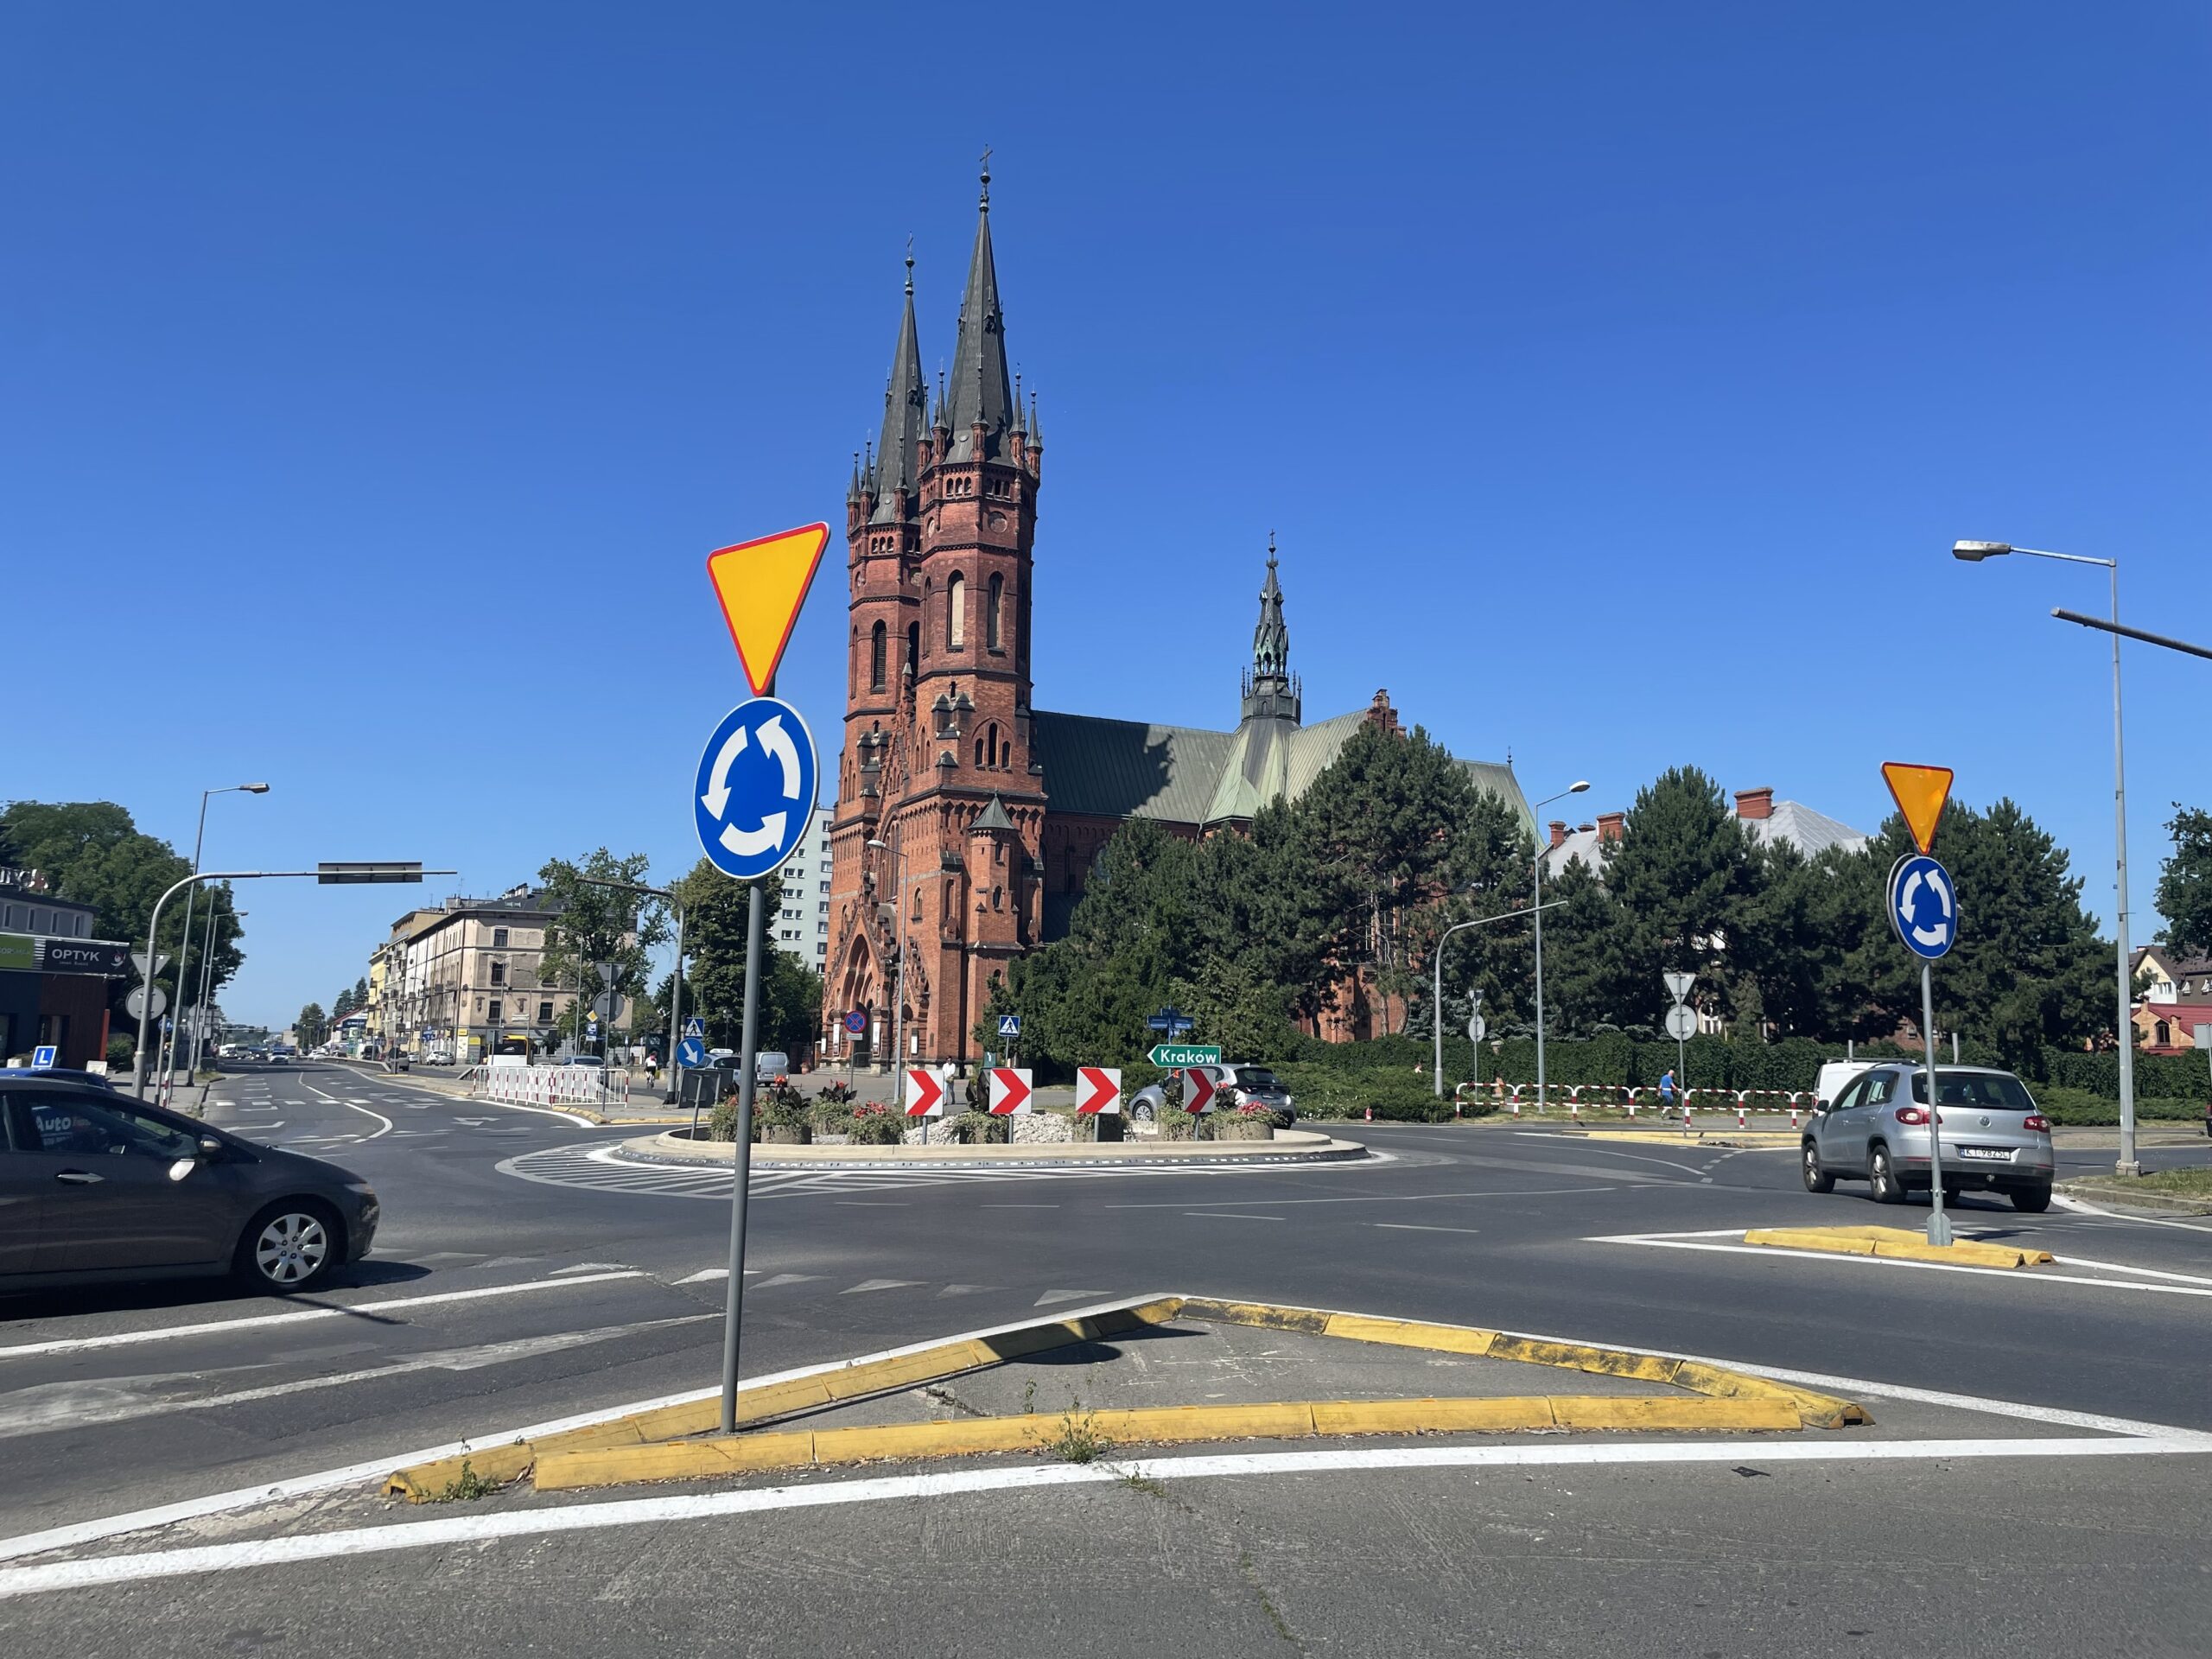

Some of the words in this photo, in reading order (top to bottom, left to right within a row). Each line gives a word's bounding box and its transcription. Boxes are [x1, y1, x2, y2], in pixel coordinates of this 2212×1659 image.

[52, 949, 100, 962] OPTYK
[39, 1050, 48, 1064] L
[1160, 1049, 1217, 1064] Kraków
